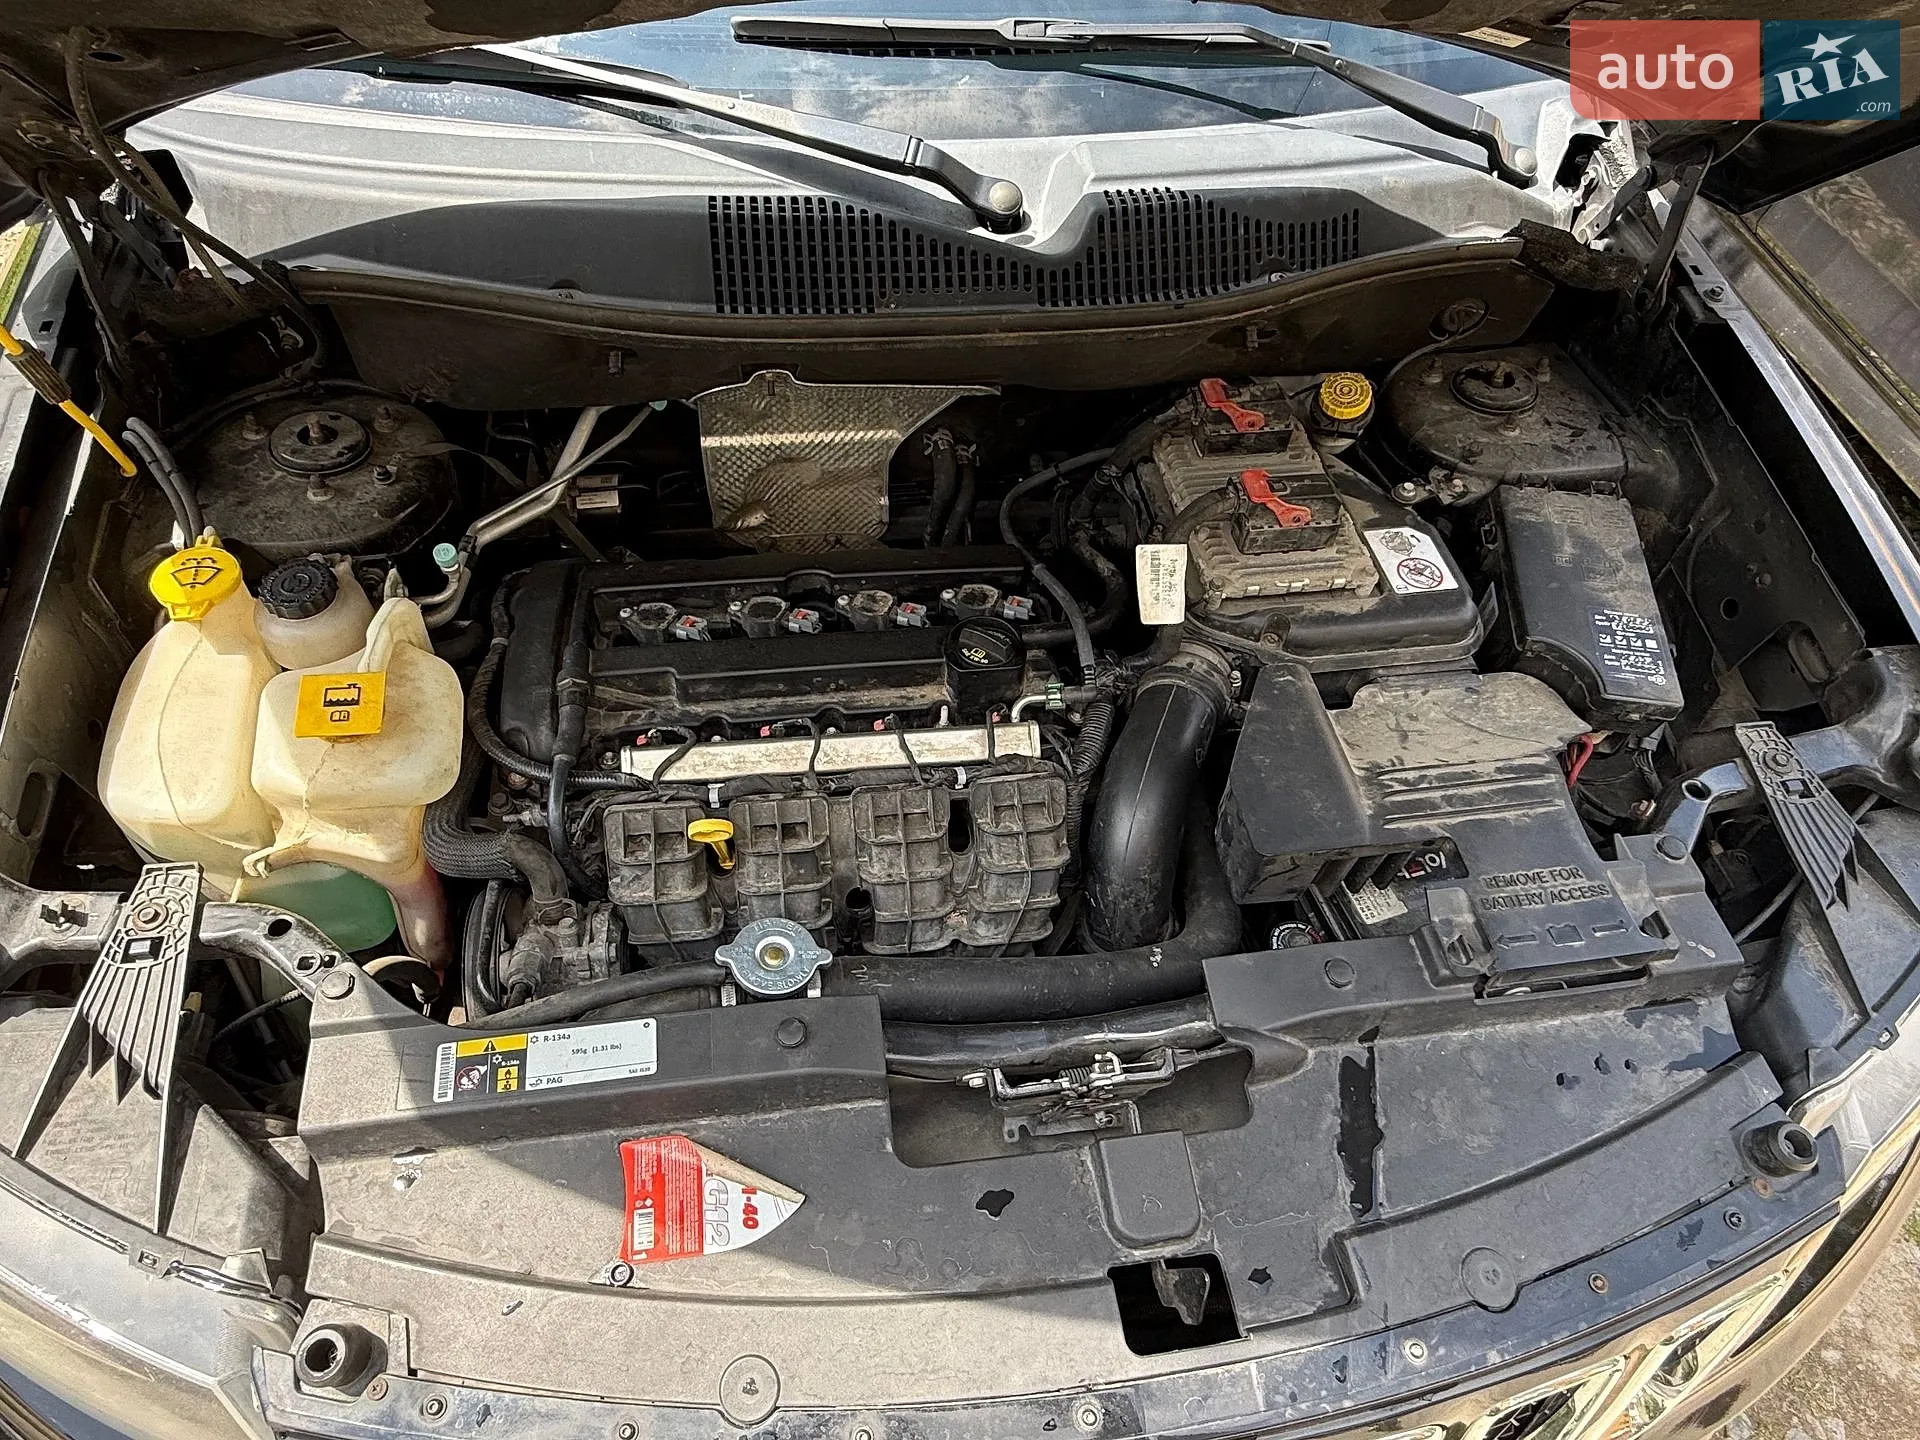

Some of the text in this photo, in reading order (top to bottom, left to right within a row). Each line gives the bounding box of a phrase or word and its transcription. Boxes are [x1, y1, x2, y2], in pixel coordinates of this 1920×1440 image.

[1482, 866, 1584, 889] REMOVE FOR
[1480, 883, 1610, 910] BATTERY ACCESS
[776, 967, 810, 990] SLOWLY
[543, 1033, 571, 1043] R-134a
[546, 1076, 563, 1085] PAG
